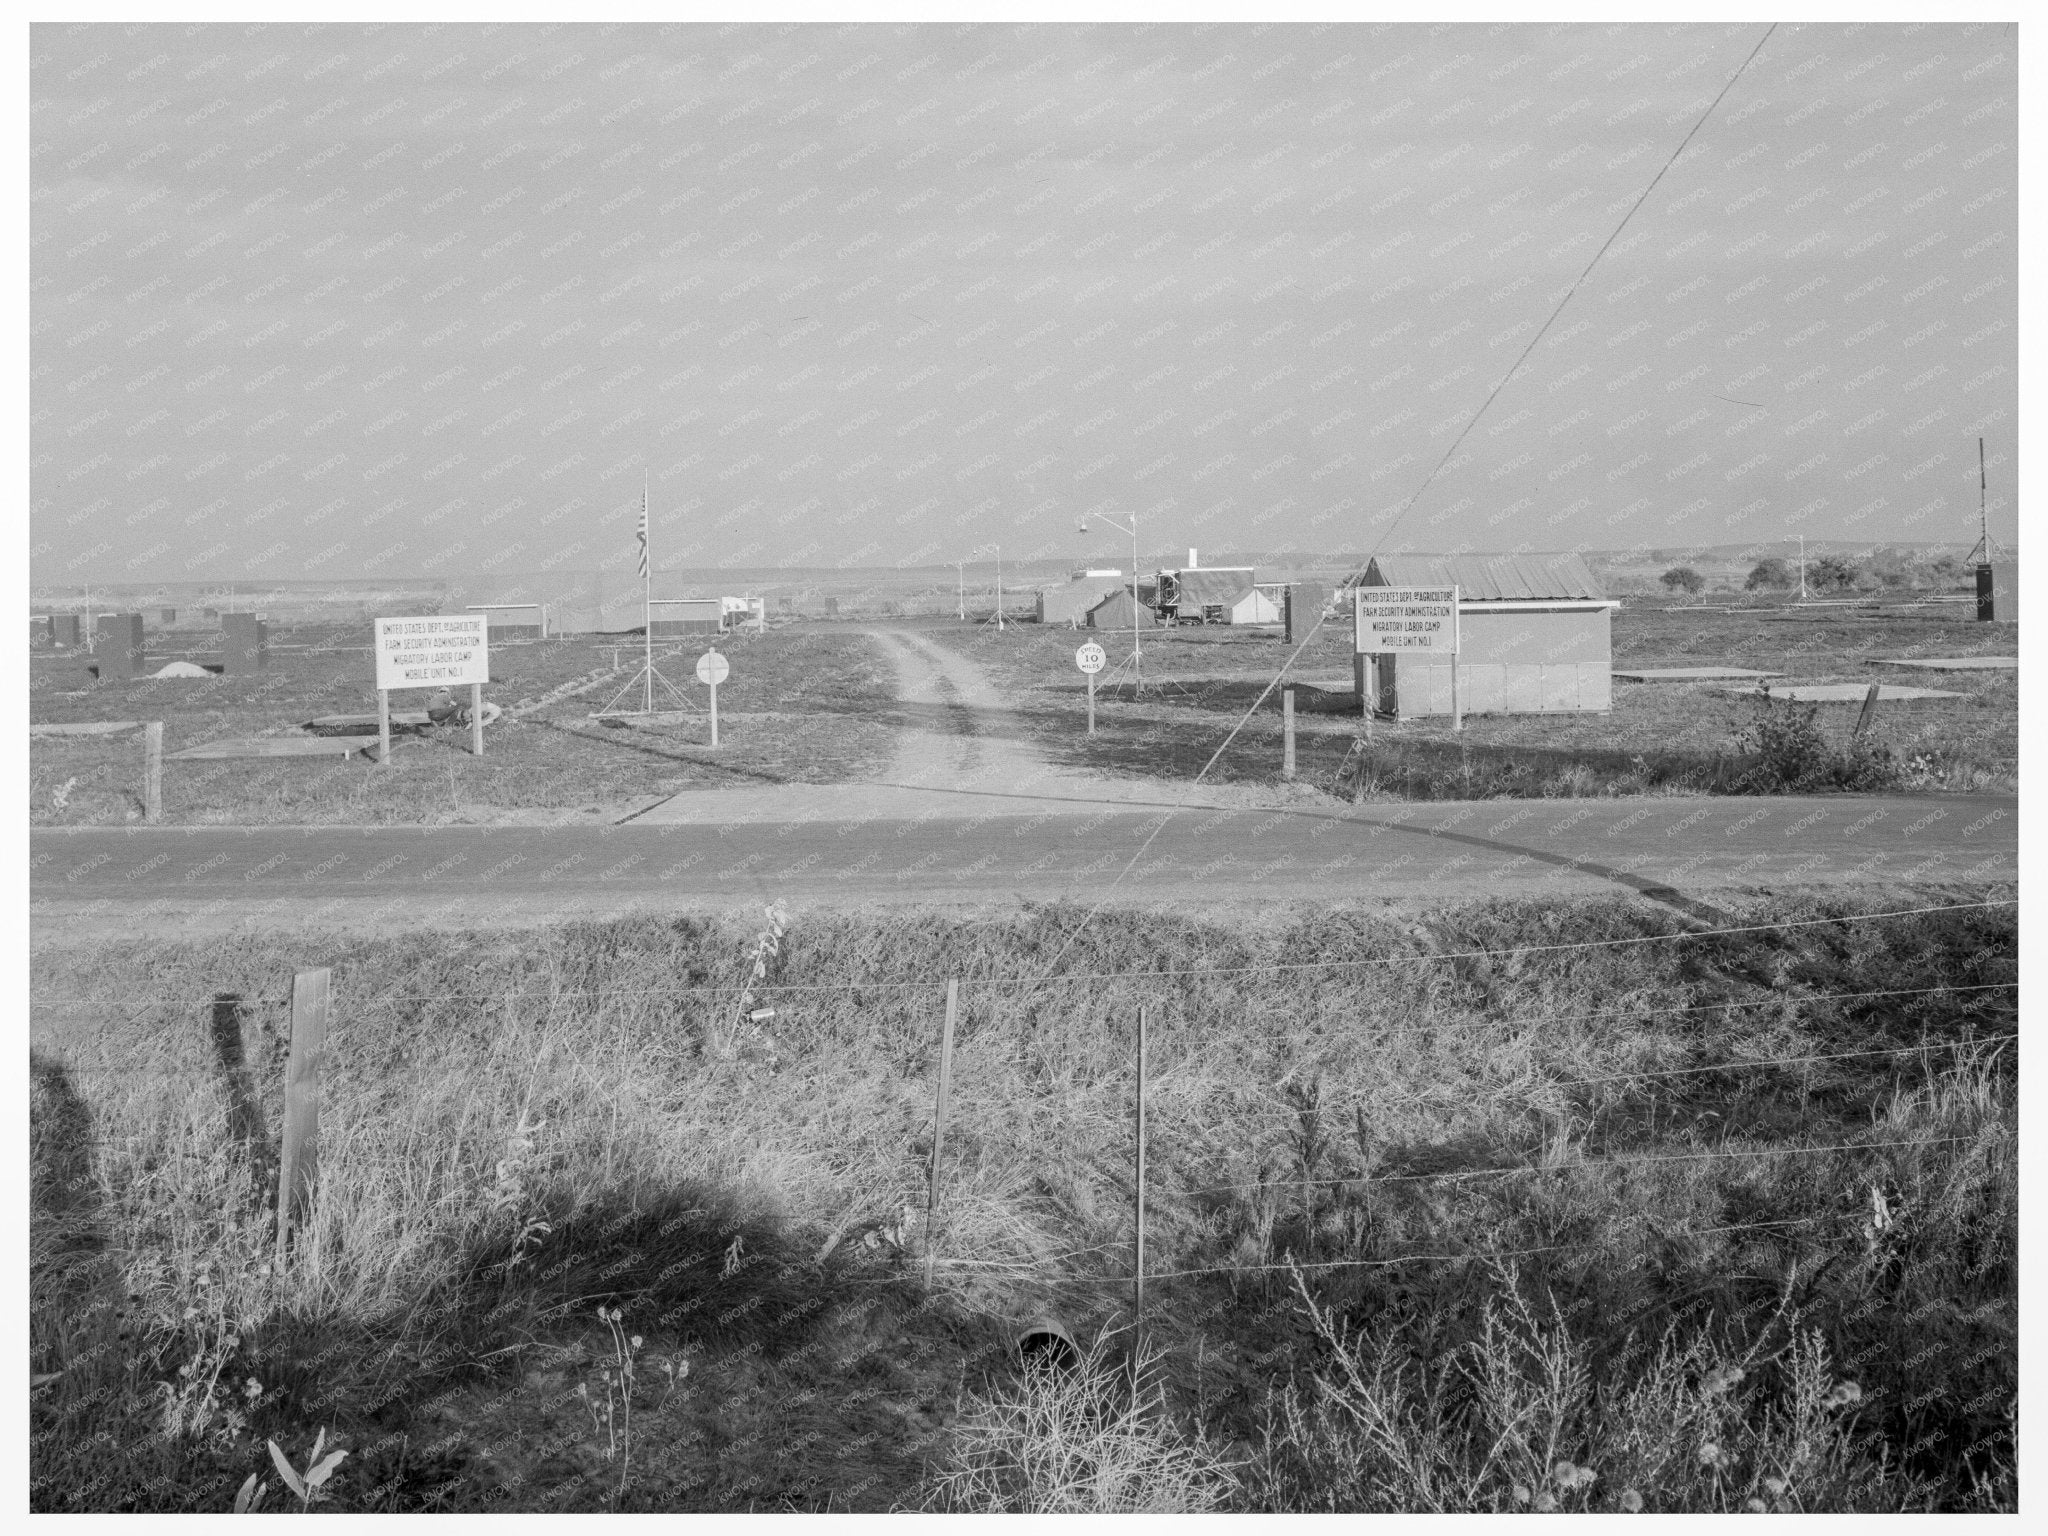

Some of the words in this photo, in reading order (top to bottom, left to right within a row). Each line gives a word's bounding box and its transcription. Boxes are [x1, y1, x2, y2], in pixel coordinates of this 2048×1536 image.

[1361, 593, 1378, 602] UNITED
[1380, 593, 1398, 602] STATES
[1420, 592, 1453, 601] AGRICULTURE
[1363, 607, 1377, 617] FARM
[1379, 607, 1404, 616] SECURITY
[1405, 607, 1450, 616] ADMINISTRATION
[383, 624, 402, 635] UNITED
[405, 623, 426, 634] STATES
[450, 621, 480, 632] AGRICULTURE
[1373, 622, 1403, 631] MIGRATORY
[1405, 622, 1423, 631] LABOR
[1425, 621, 1440, 631] CAMP
[386, 640, 401, 650] FARM
[404, 639, 431, 649] SECURITY
[434, 637, 480, 647] ADMINISTRATION
[1382, 637, 1402, 646] MOBILE
[1404, 637, 1417, 646] UNIT
[394, 654, 428, 665] MIGRATORY
[432, 652, 452, 663] LABOR
[454, 652, 472, 662] CAMP
[405, 669, 429, 679] MOBILE
[431, 668, 446, 678] UNIT
